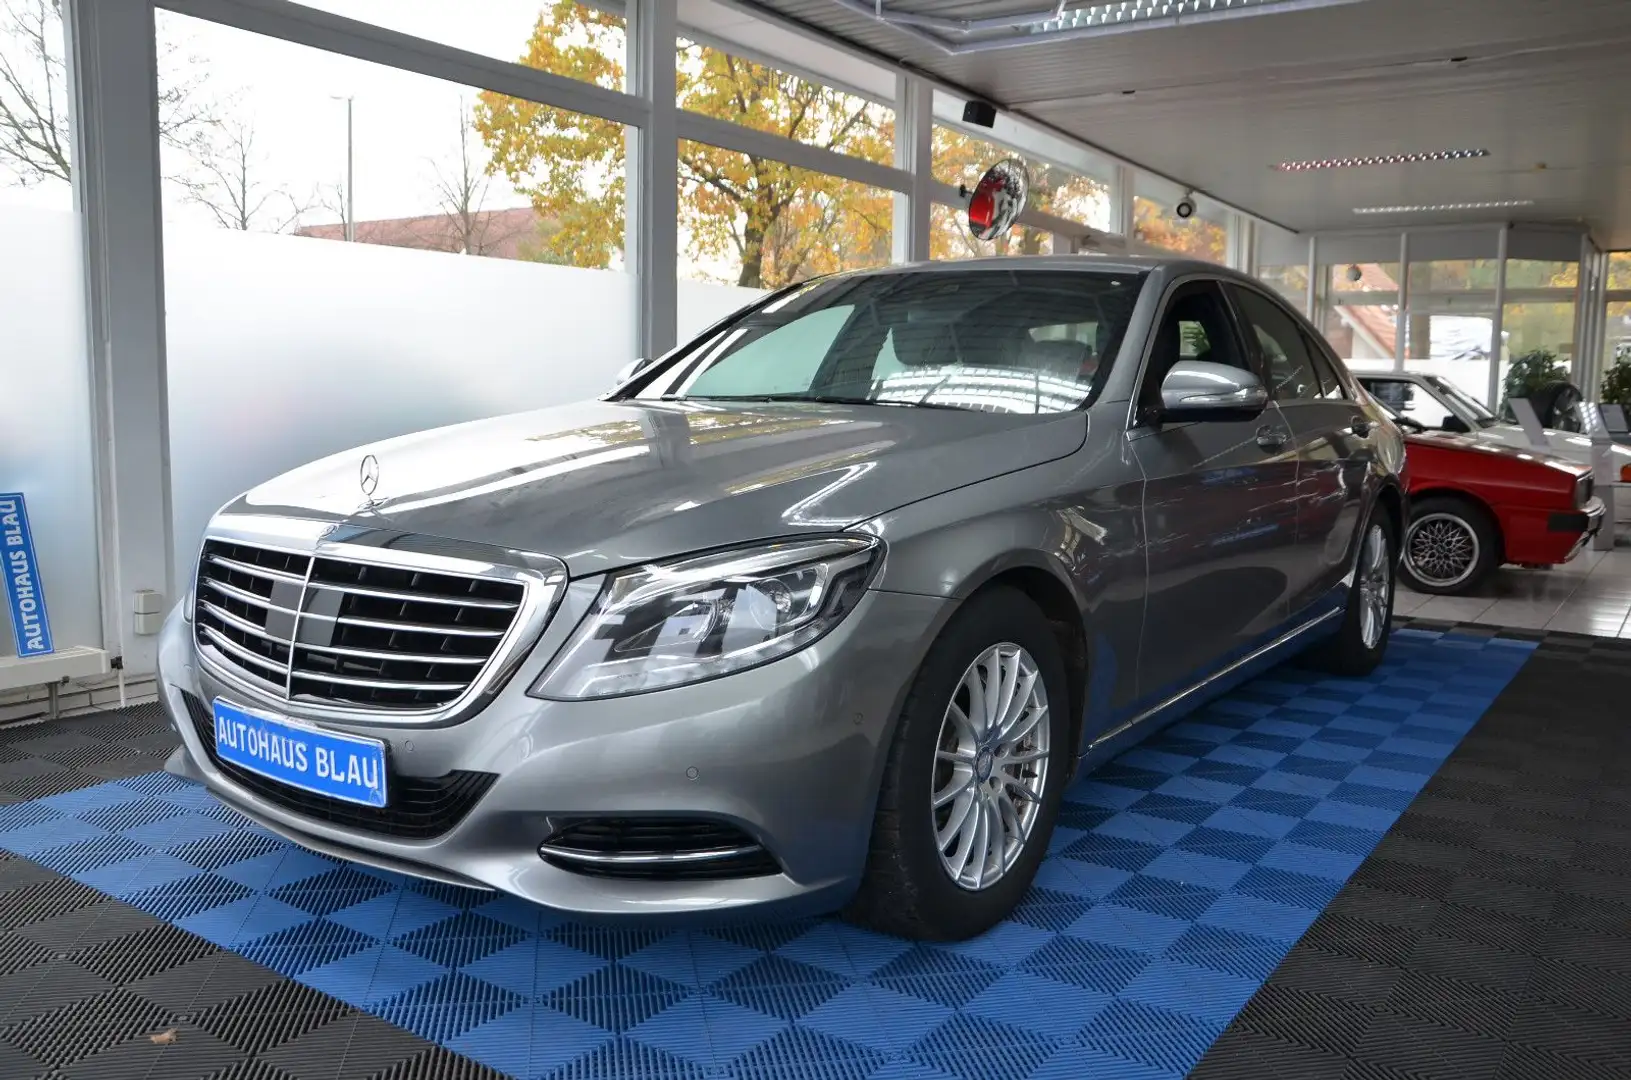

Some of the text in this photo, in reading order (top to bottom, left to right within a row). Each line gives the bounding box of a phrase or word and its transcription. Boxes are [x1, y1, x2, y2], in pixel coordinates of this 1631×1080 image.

[0, 499, 45, 650] AUTOHAUS BLAU
[218, 716, 379, 789] AUTOHAUS BLAU
